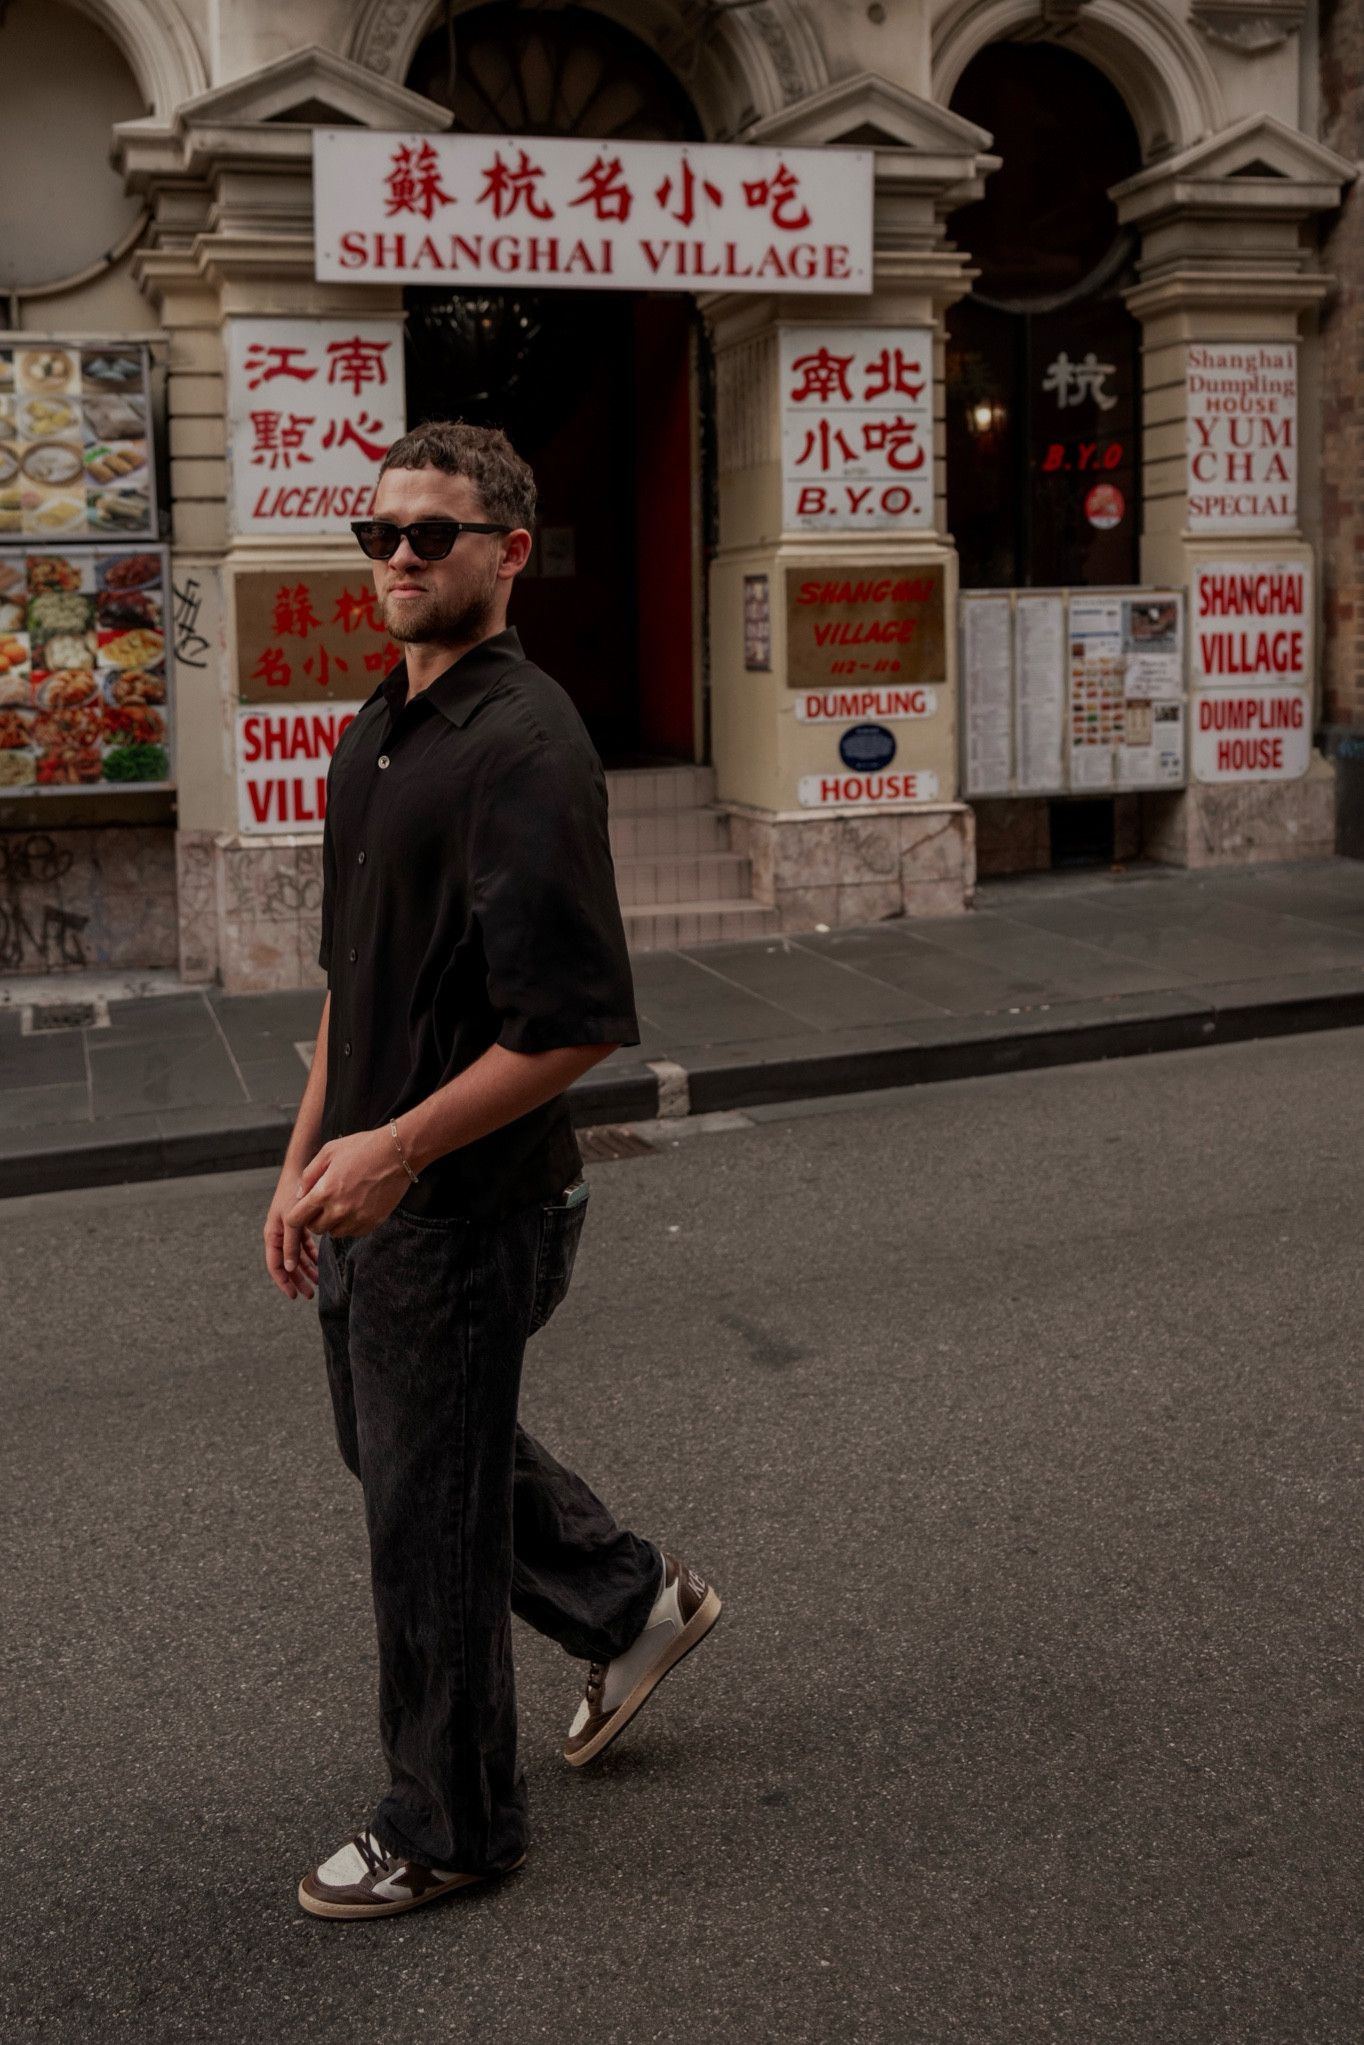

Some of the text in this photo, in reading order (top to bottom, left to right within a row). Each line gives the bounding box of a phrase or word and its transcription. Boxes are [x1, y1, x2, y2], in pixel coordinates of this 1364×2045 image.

[384, 139, 811, 231] 蘇杭名小吃
[338, 231, 851, 279] SHANGHAI VILLAGE
[244, 336, 392, 396] 江南
[791, 346, 927, 402] 南北
[1188, 350, 1293, 373] Shanghai
[1041, 351, 1119, 411] 杭
[1189, 374, 1296, 398] Dumpling
[1206, 396, 1279, 413] HOUSE
[249, 410, 391, 470] 點心
[795, 416, 925, 471] 小吃
[1193, 416, 1293, 449] YUM
[1191, 450, 1289, 483] CHA
[796, 485, 922, 515] B.Y.O.
[1188, 495, 1297, 517] SPECIAL
[271, 582, 388, 639] 蘇杭
[1199, 573, 1304, 617] SHANGHAI
[814, 618, 918, 647] VILLAGE
[1200, 630, 1304, 675] VILLAGE
[805, 690, 927, 719] DUMPLING
[1199, 698, 1304, 732] DUMPLING
[1217, 737, 1283, 771] HOUSE
[820, 774, 918, 801] HOUSE
